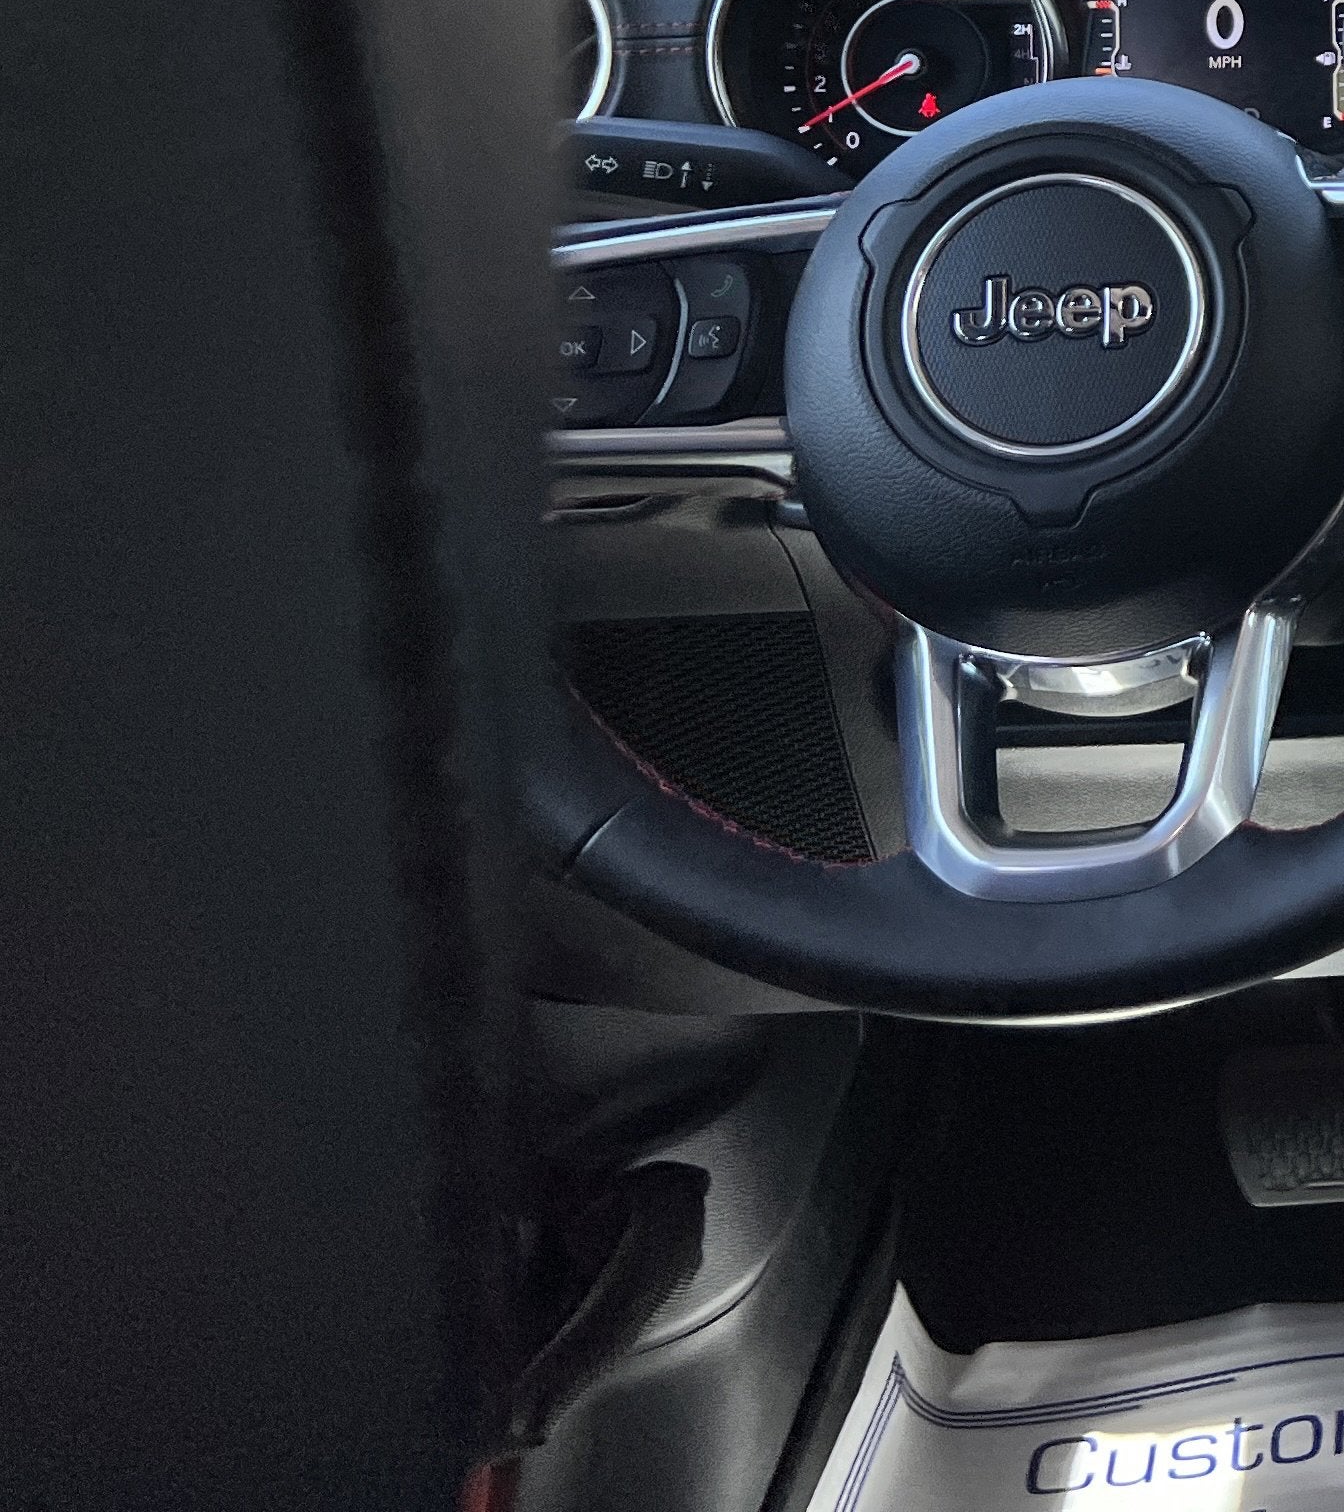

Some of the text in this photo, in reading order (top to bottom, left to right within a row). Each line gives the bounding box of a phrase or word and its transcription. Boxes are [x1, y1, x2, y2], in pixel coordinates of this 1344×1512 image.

[1013, 24, 1031, 35] 2H
[1208, 56, 1242, 68] MPH
[814, 76, 827, 93] 2
[1324, 117, 1332, 128] E
[846, 133, 860, 148] 0
[953, 276, 1153, 347] Jeep
[560, 340, 586, 357] OK
